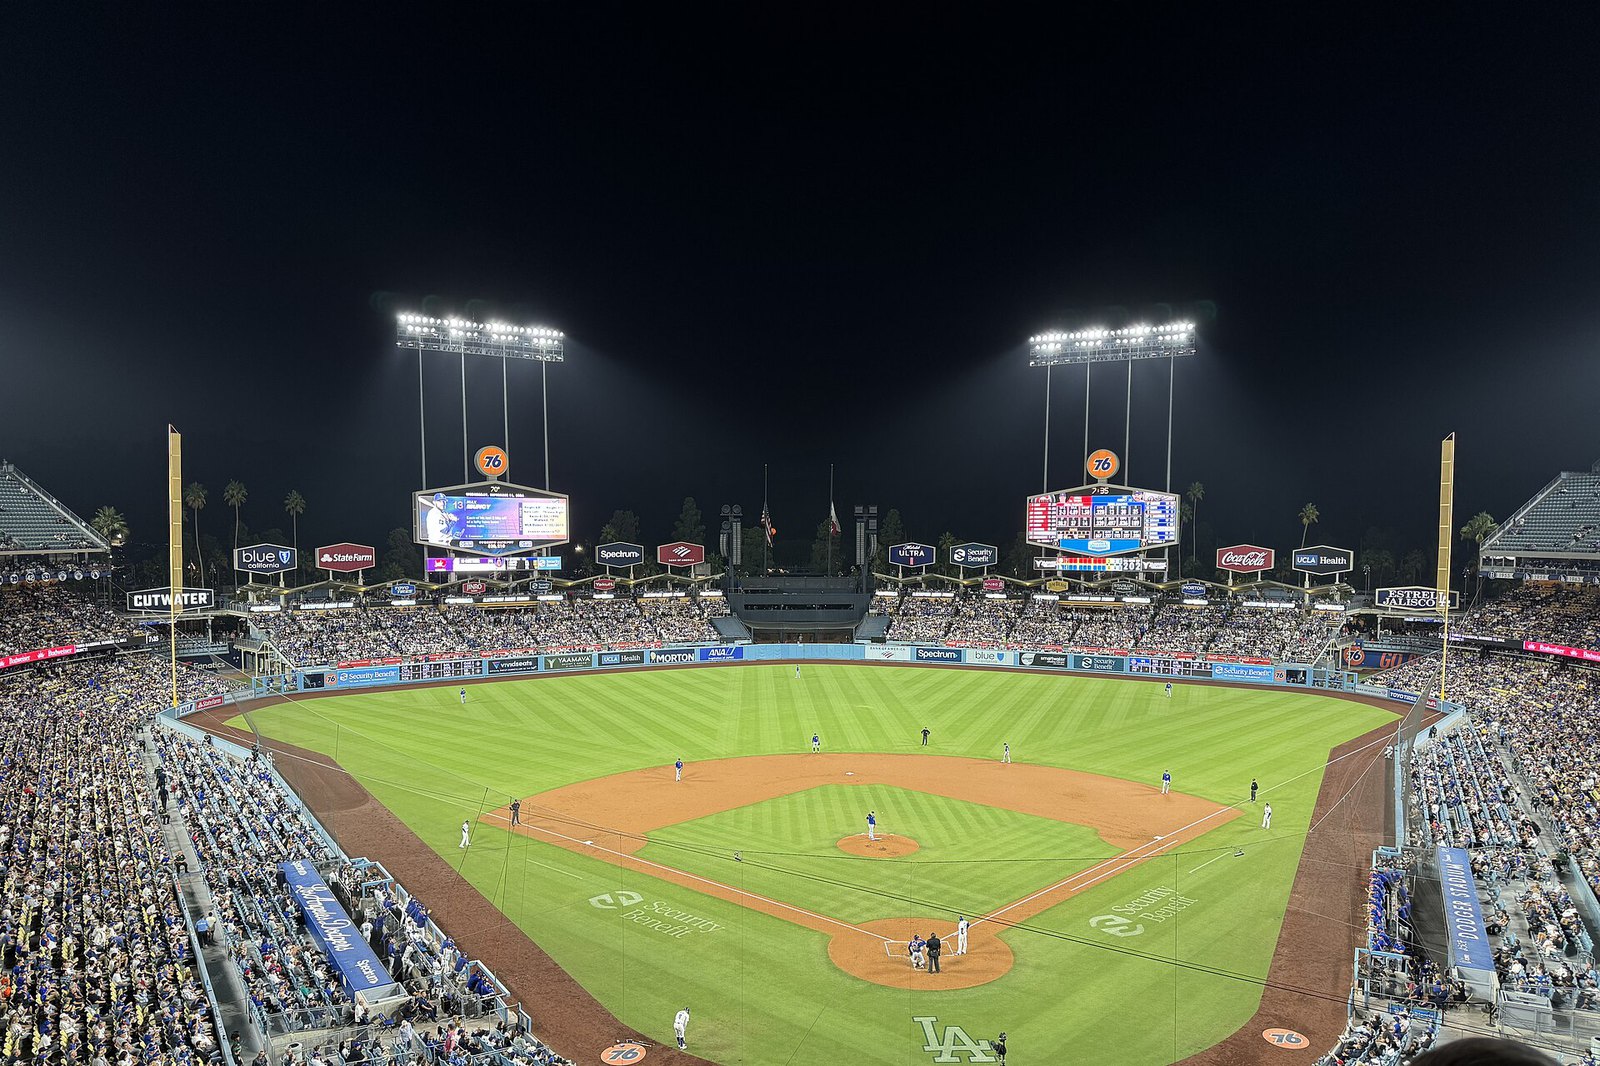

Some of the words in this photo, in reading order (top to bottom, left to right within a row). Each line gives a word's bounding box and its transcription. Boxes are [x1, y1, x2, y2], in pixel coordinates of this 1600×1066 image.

[484, 455, 502, 469] 76
[1093, 457, 1111, 472] 76
[1091, 487, 1109, 495] 7:35
[453, 501, 463, 510] 13
[242, 550, 275, 563] blue
[600, 550, 637, 559] Spectrum
[967, 548, 993, 557] Security
[1221, 551, 1268, 566] Coca-Cola
[1319, 556, 1347, 565] Health
[133, 593, 208, 607] CUTWATER
[1382, 597, 1435, 607] JALISCO
[656, 653, 694, 662] MORTON
[709, 648, 726, 656] ANA
[918, 649, 956, 659] Spectrum
[975, 651, 995, 660] blue
[1093, 658, 1116, 666] Security
[1224, 668, 1248, 676] Security
[326, 675, 335, 683] 76
[1445, 863, 1471, 898] STADIUM
[1112, 885, 1178, 915] Security
[1137, 895, 1198, 923] Benefit
[643, 900, 725, 933] Security
[1452, 899, 1479, 940] DODGER
[620, 909, 694, 939] Benefit
[321, 918, 355, 952] Dodgers
[355, 959, 379, 984] Spectrum
[912, 1016, 998, 1063] LA
[1270, 1032, 1303, 1045] 76
[607, 1047, 640, 1061] 76
